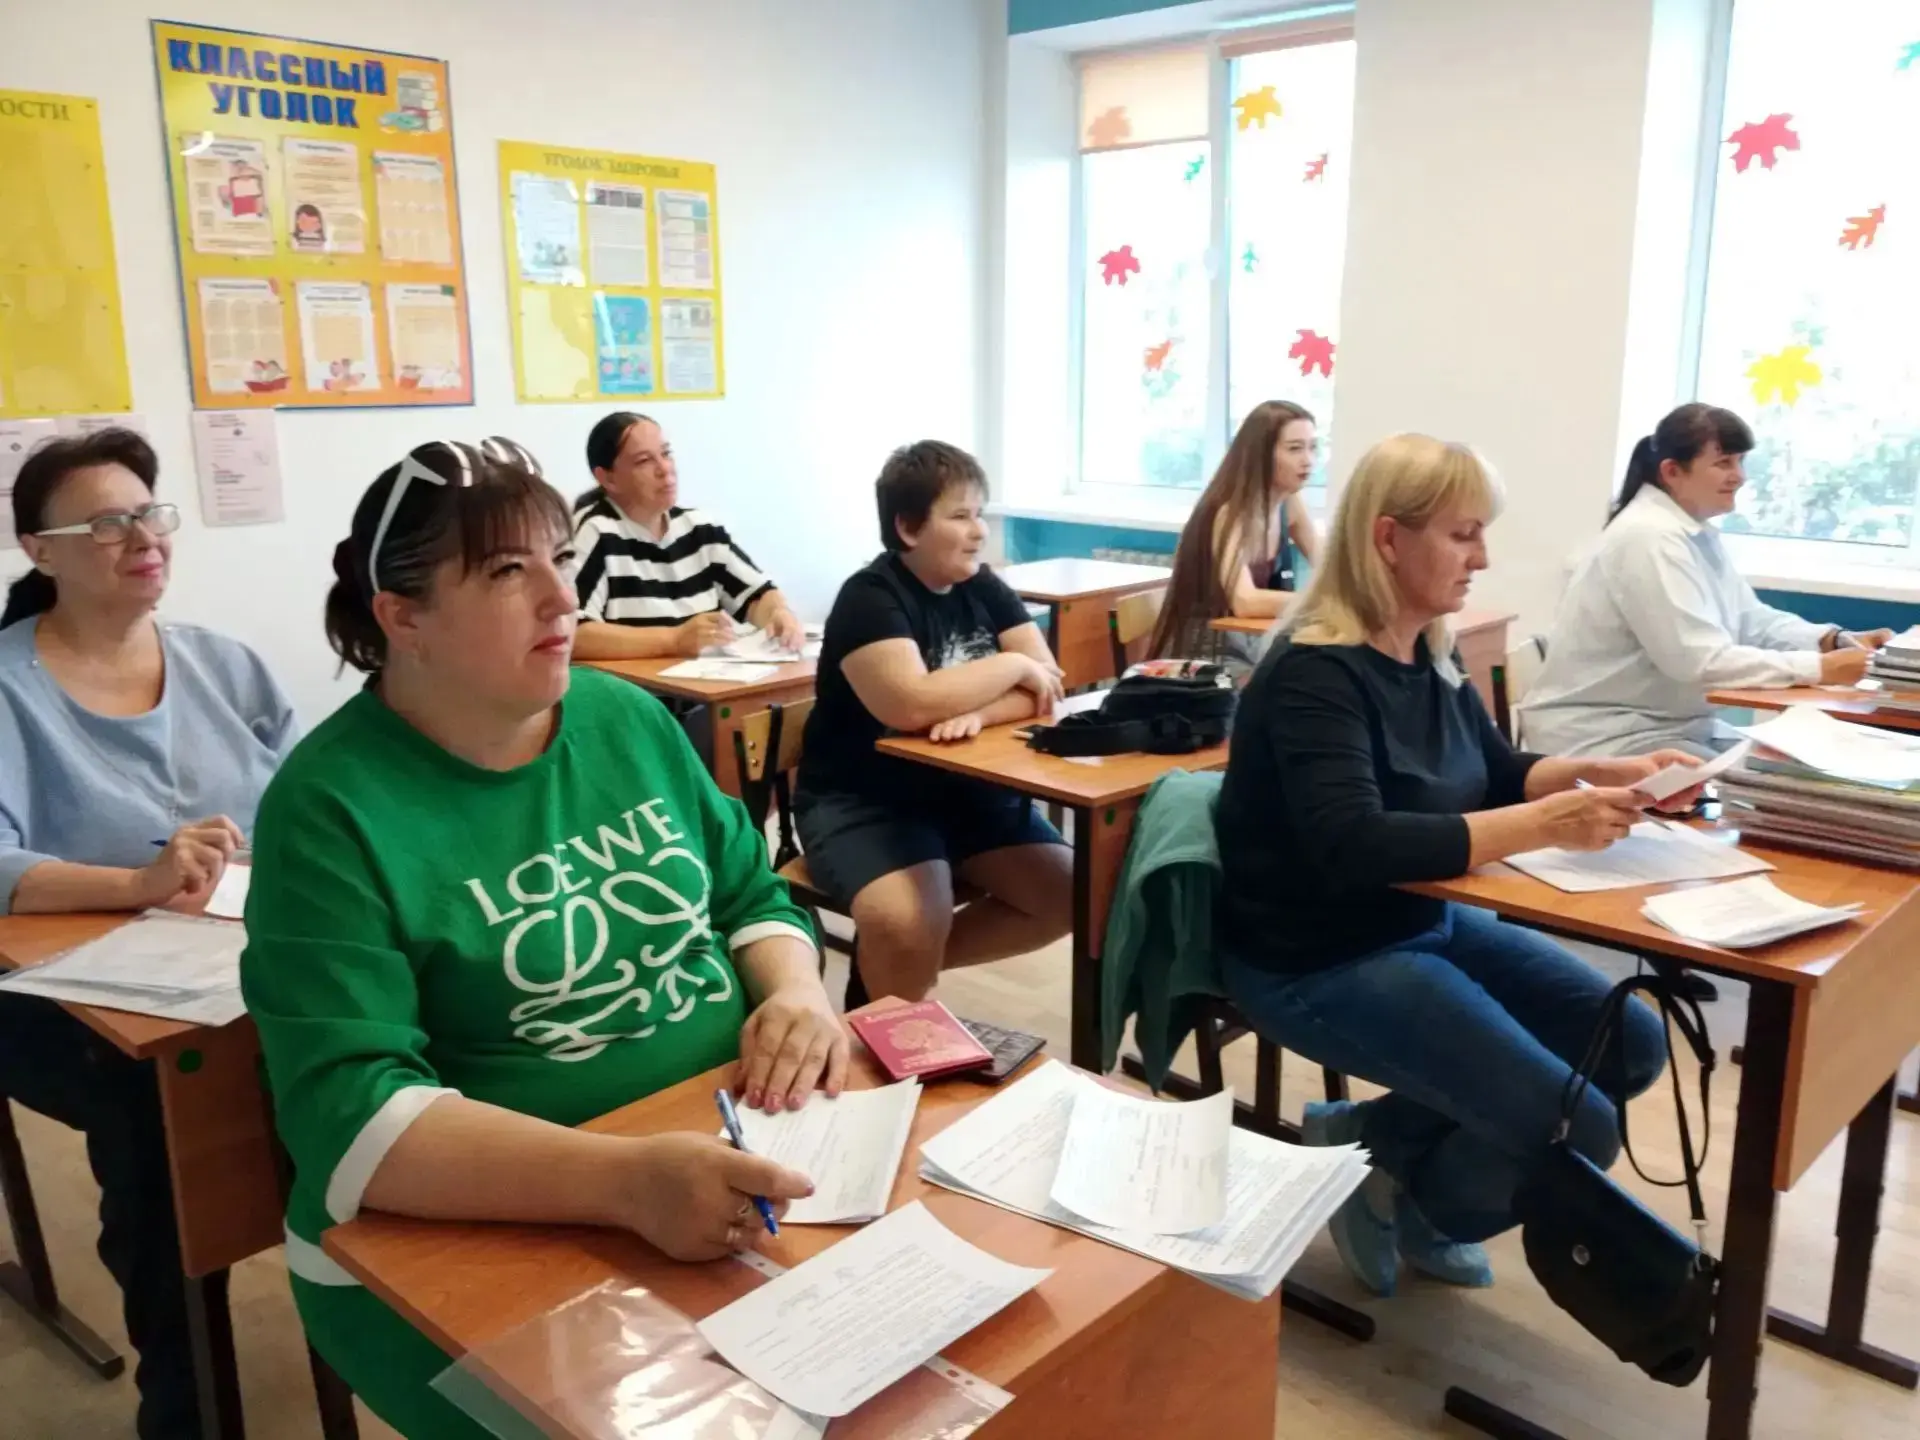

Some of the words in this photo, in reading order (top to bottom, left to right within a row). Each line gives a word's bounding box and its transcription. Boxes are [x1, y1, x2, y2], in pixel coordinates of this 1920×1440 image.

[167, 38, 387, 96] КЛАССНЫЙ
[207, 82, 360, 128] УГОЛОК
[463, 797, 685, 926] LOEWE
